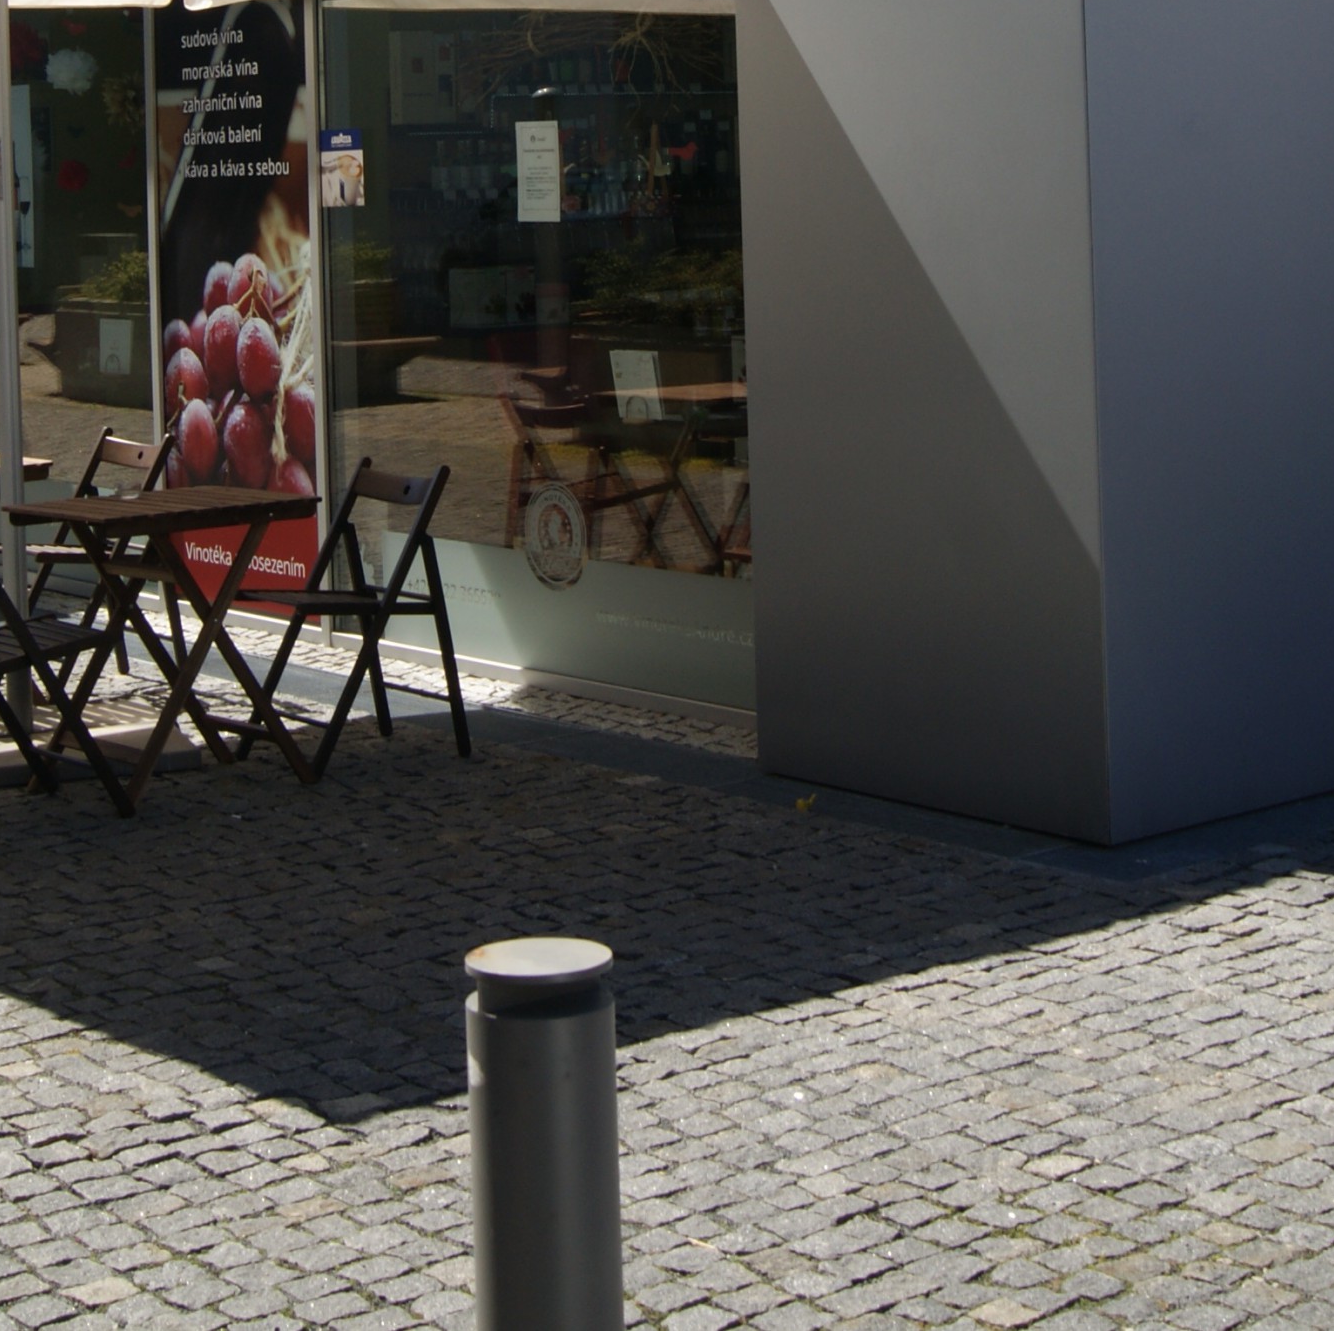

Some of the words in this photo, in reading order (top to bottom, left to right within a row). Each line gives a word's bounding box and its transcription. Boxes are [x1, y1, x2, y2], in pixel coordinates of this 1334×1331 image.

[181, 28, 218, 48] sudová
[220, 25, 244, 45] vína
[181, 60, 233, 81] moravská
[235, 57, 259, 76] vína
[182, 91, 238, 113] zahraniční
[239, 90, 263, 109] vína
[183, 125, 226, 145] dárková
[227, 123, 263, 144] balení
[184, 159, 209, 178] káva
[210, 164, 217, 177] a
[219, 158, 245, 177] káva
[247, 164, 254, 176] s
[255, 157, 290, 176] sebou
[185, 542, 233, 567] Vinotéka
[248, 555, 306, 579] osezením
